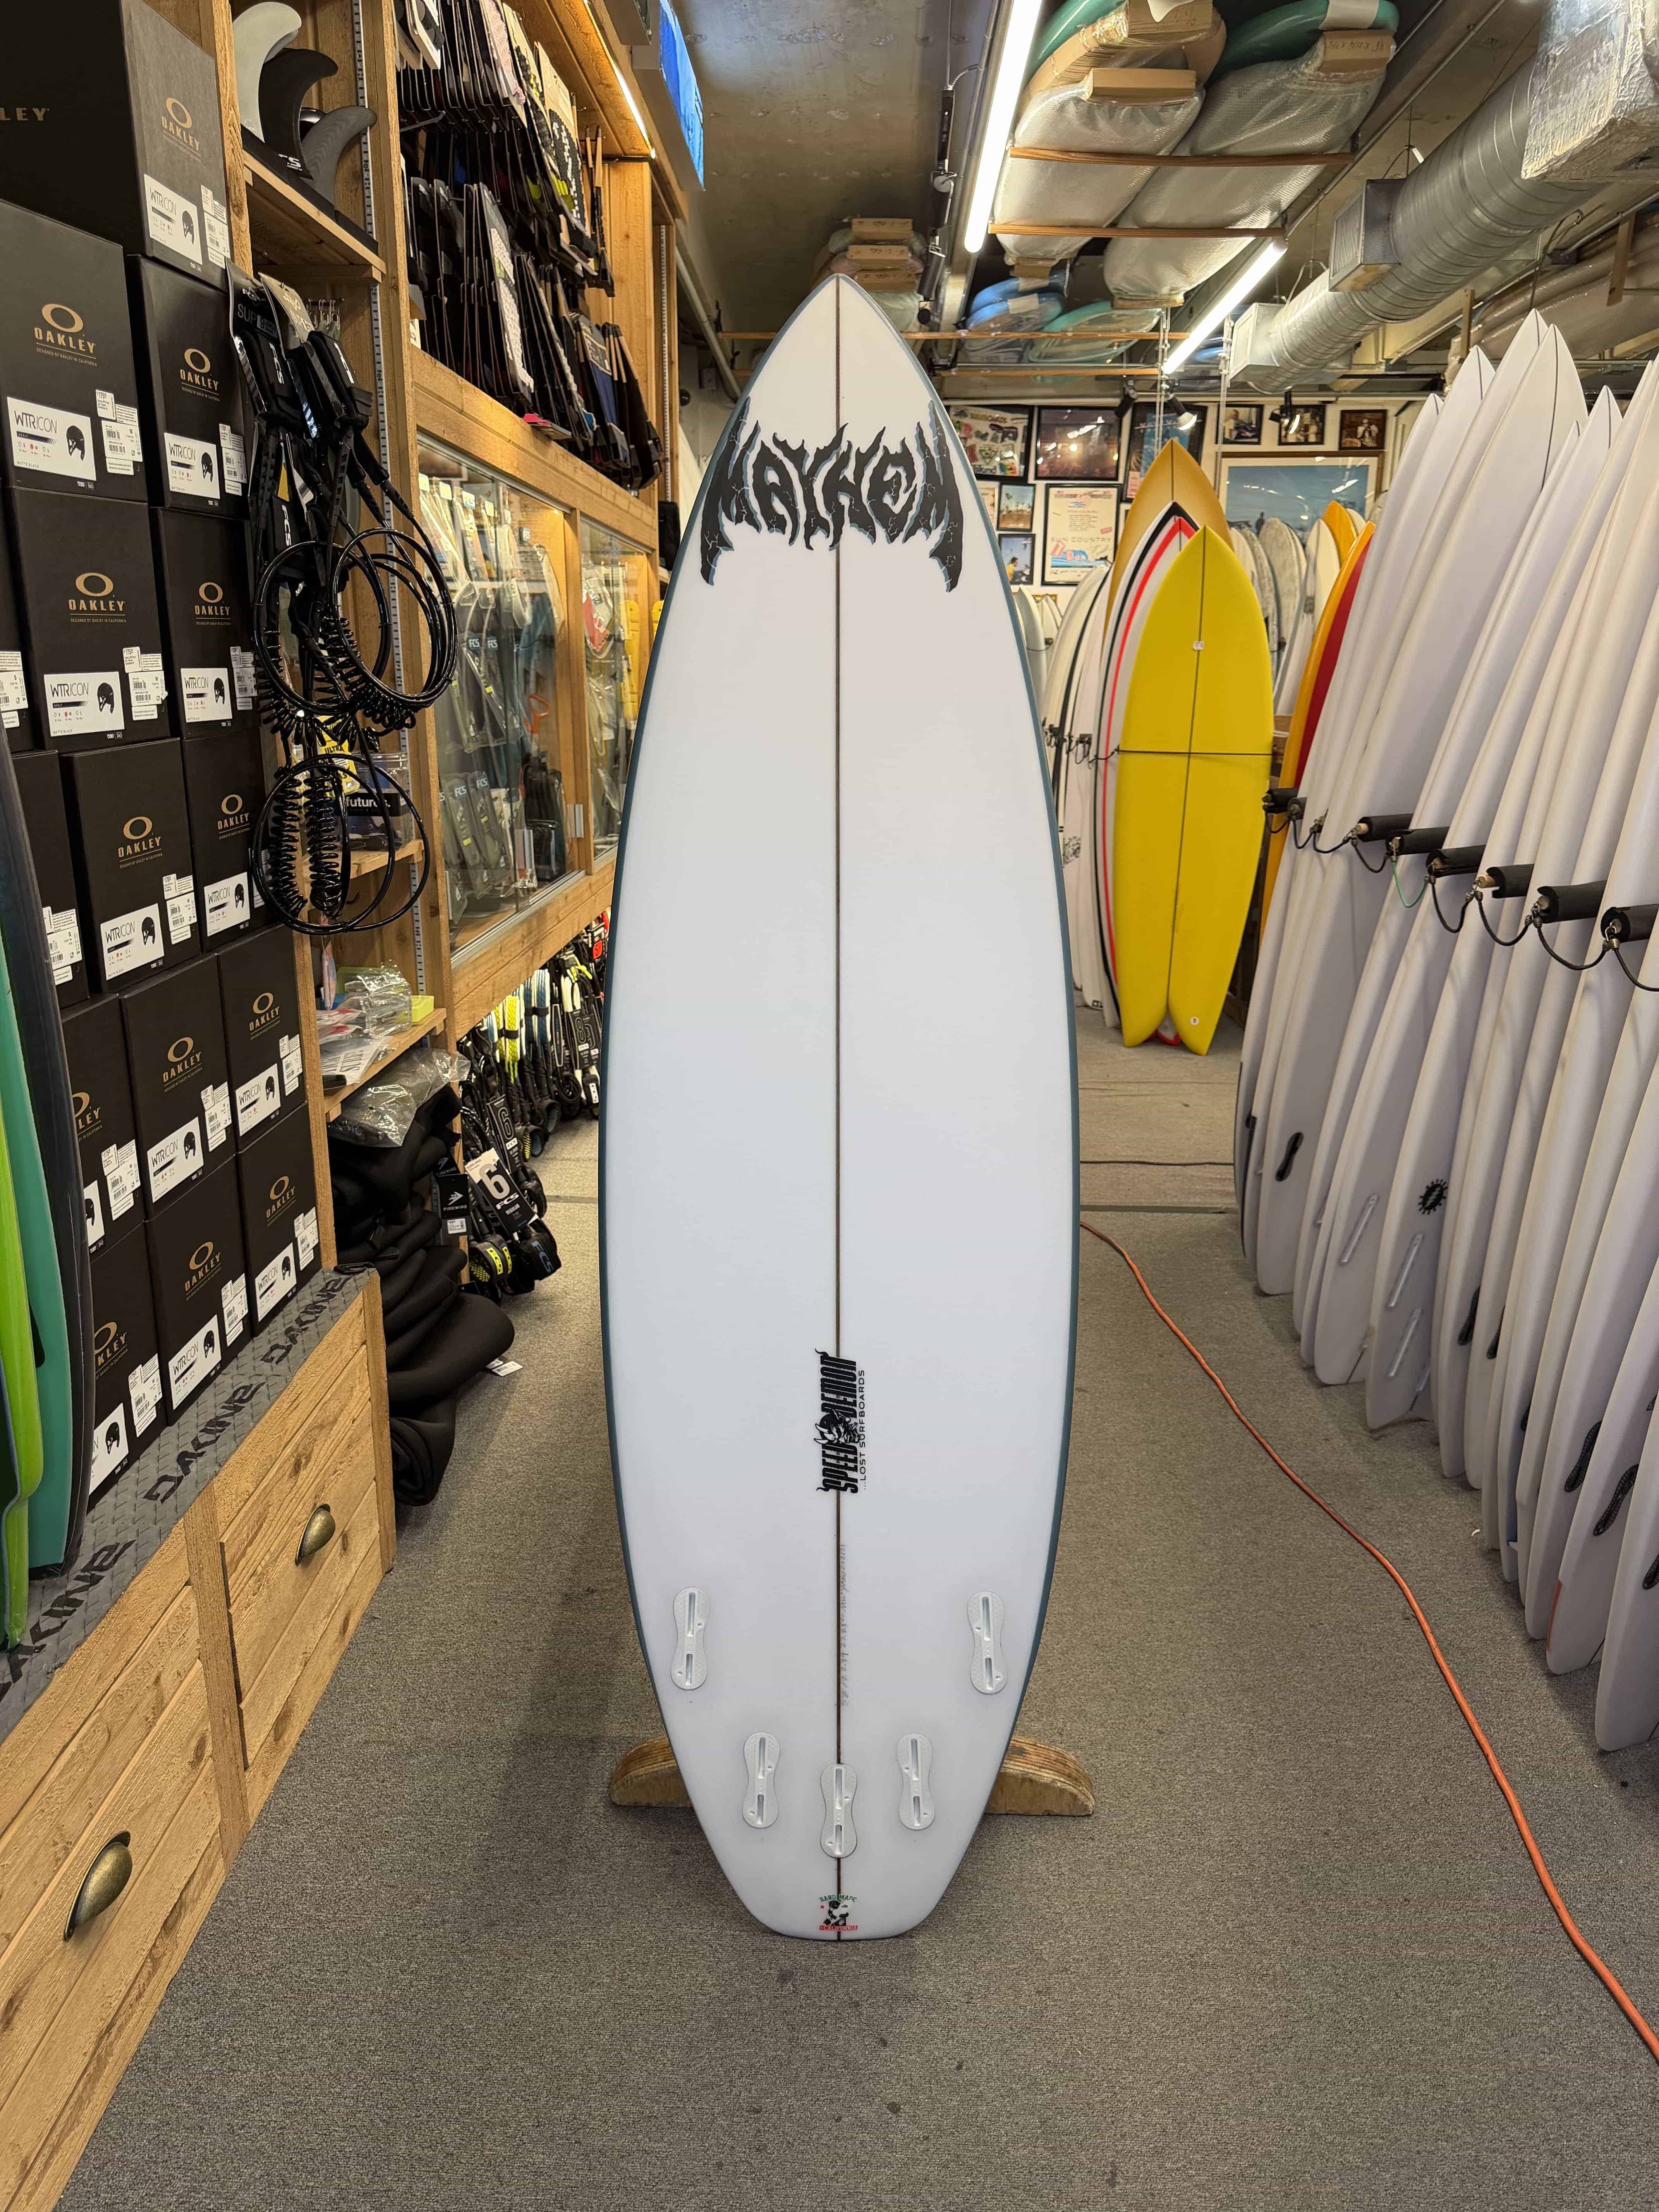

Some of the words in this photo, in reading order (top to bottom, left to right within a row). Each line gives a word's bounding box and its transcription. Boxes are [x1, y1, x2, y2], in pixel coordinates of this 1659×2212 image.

[161, 116, 200, 151] OAKLEY
[149, 187, 177, 216] WTRICON
[34, 327, 95, 354] OAKLEY
[180, 369, 218, 391] OAKLEY
[14, 410, 57, 434] WTRICON
[169, 443, 196, 461] WTRICON
[701, 397, 963, 593] MAYHEM
[69, 599, 124, 611] OAKLEY
[195, 605, 230, 615] OAKLEY
[469, 639, 480, 648] FCS
[487, 639, 498, 648] FCS
[50, 682, 89, 697] WTRICON
[184, 677, 208, 689] WTRICON
[325, 745, 345, 754] ULTRA
[454, 785, 467, 797] FCS
[476, 777, 488, 788] FCS
[346, 797, 391, 807] futur.
[217, 812, 249, 830] OAKLEY
[118, 836, 161, 858] OAKLEY
[208, 886, 230, 905] WTRICON
[105, 920, 135, 943] WTRICON
[249, 1006, 280, 1031] OAKLEY
[162, 1052, 201, 1083] OAKLEY
[239, 1082, 261, 1105] WTRICON
[78, 1107, 100, 1129] LEY
[151, 1139, 179, 1167] WTRICON
[479, 1163, 510, 1200] 6
[266, 1186, 295, 1218] OAKLEY
[495, 1192, 519, 1210] FCS
[532, 1240, 555, 1274] FCS
[185, 1252, 221, 1291] OAKLEY
[258, 1264, 278, 1292] WTRICON
[97, 1332, 126, 1367] KLEY
[173, 1341, 199, 1376] WTRICON
[143, 1380, 267, 1504] DAKINE
[816, 1443, 858, 1494] SPEED
[819, 1894, 836, 1902] HAND
